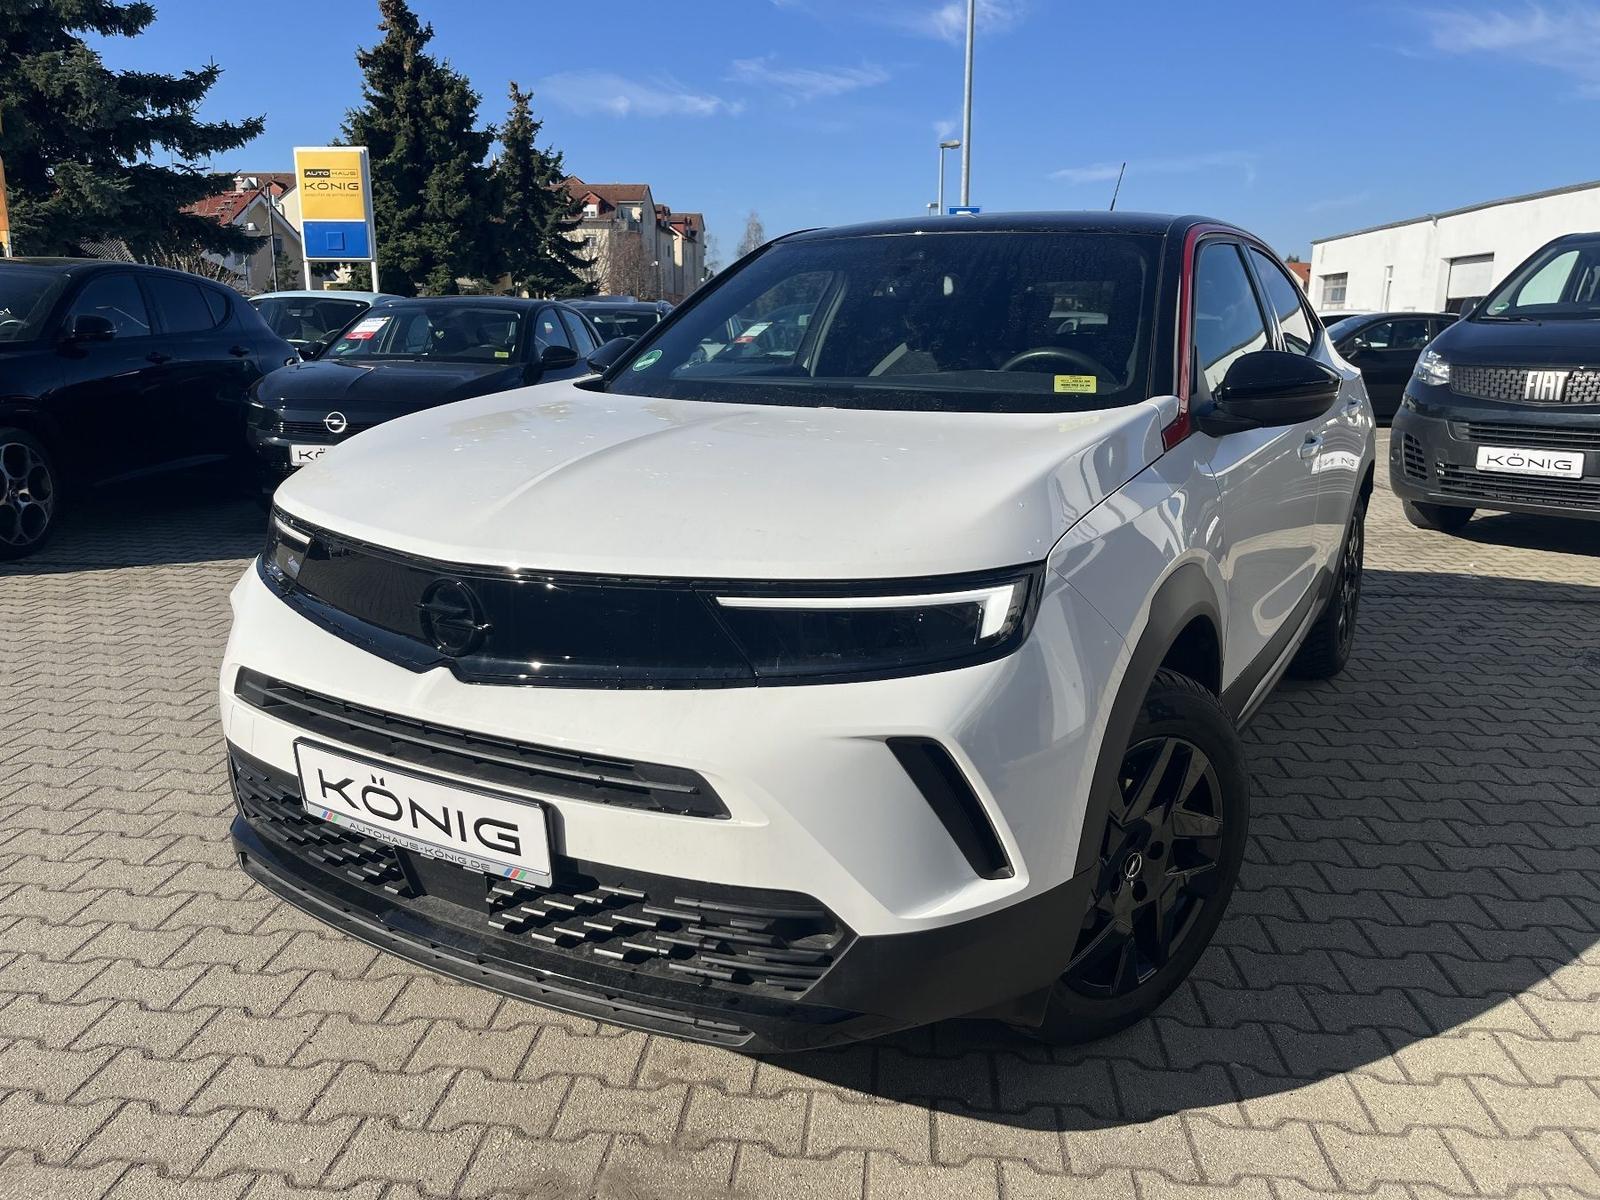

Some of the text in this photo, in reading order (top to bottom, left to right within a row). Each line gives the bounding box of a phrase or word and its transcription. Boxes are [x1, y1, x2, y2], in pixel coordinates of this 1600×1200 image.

[304, 180, 359, 191] KÖNIG
[1524, 371, 1570, 401] FIAT
[1486, 452, 1573, 471] KÖNIG
[317, 767, 522, 857] KÖNIG
